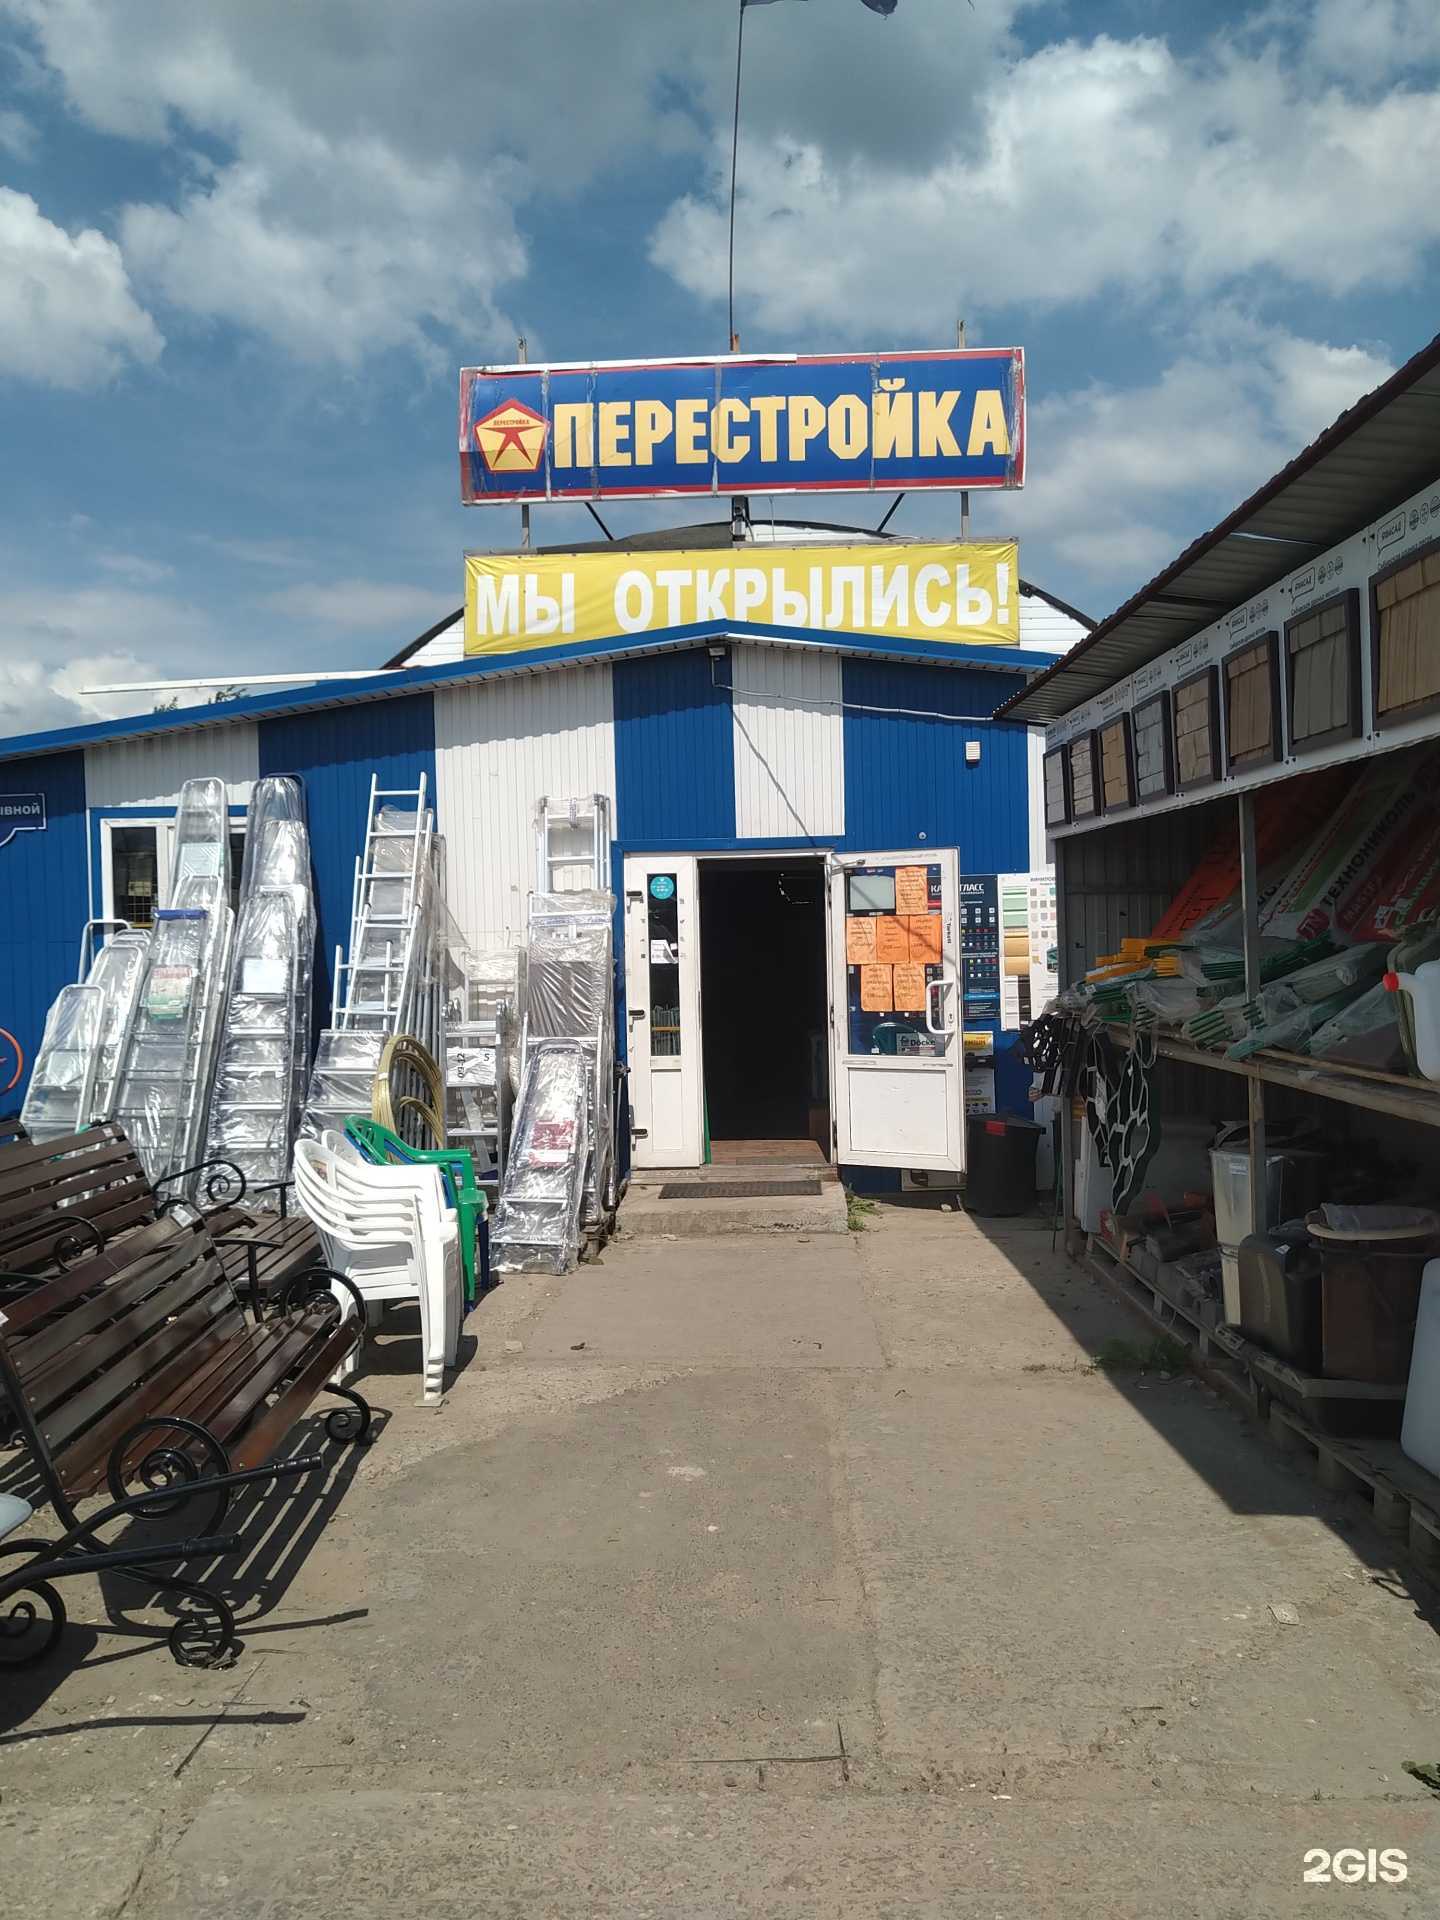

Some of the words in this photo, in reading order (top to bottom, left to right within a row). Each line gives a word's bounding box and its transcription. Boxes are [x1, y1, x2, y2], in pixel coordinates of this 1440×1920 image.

[553, 378, 1011, 469] ПЕРЕСТРОЙКА
[475, 571, 575, 636] МЫ
[613, 561, 1010, 634] ОТКРЫЛИСЬ!
